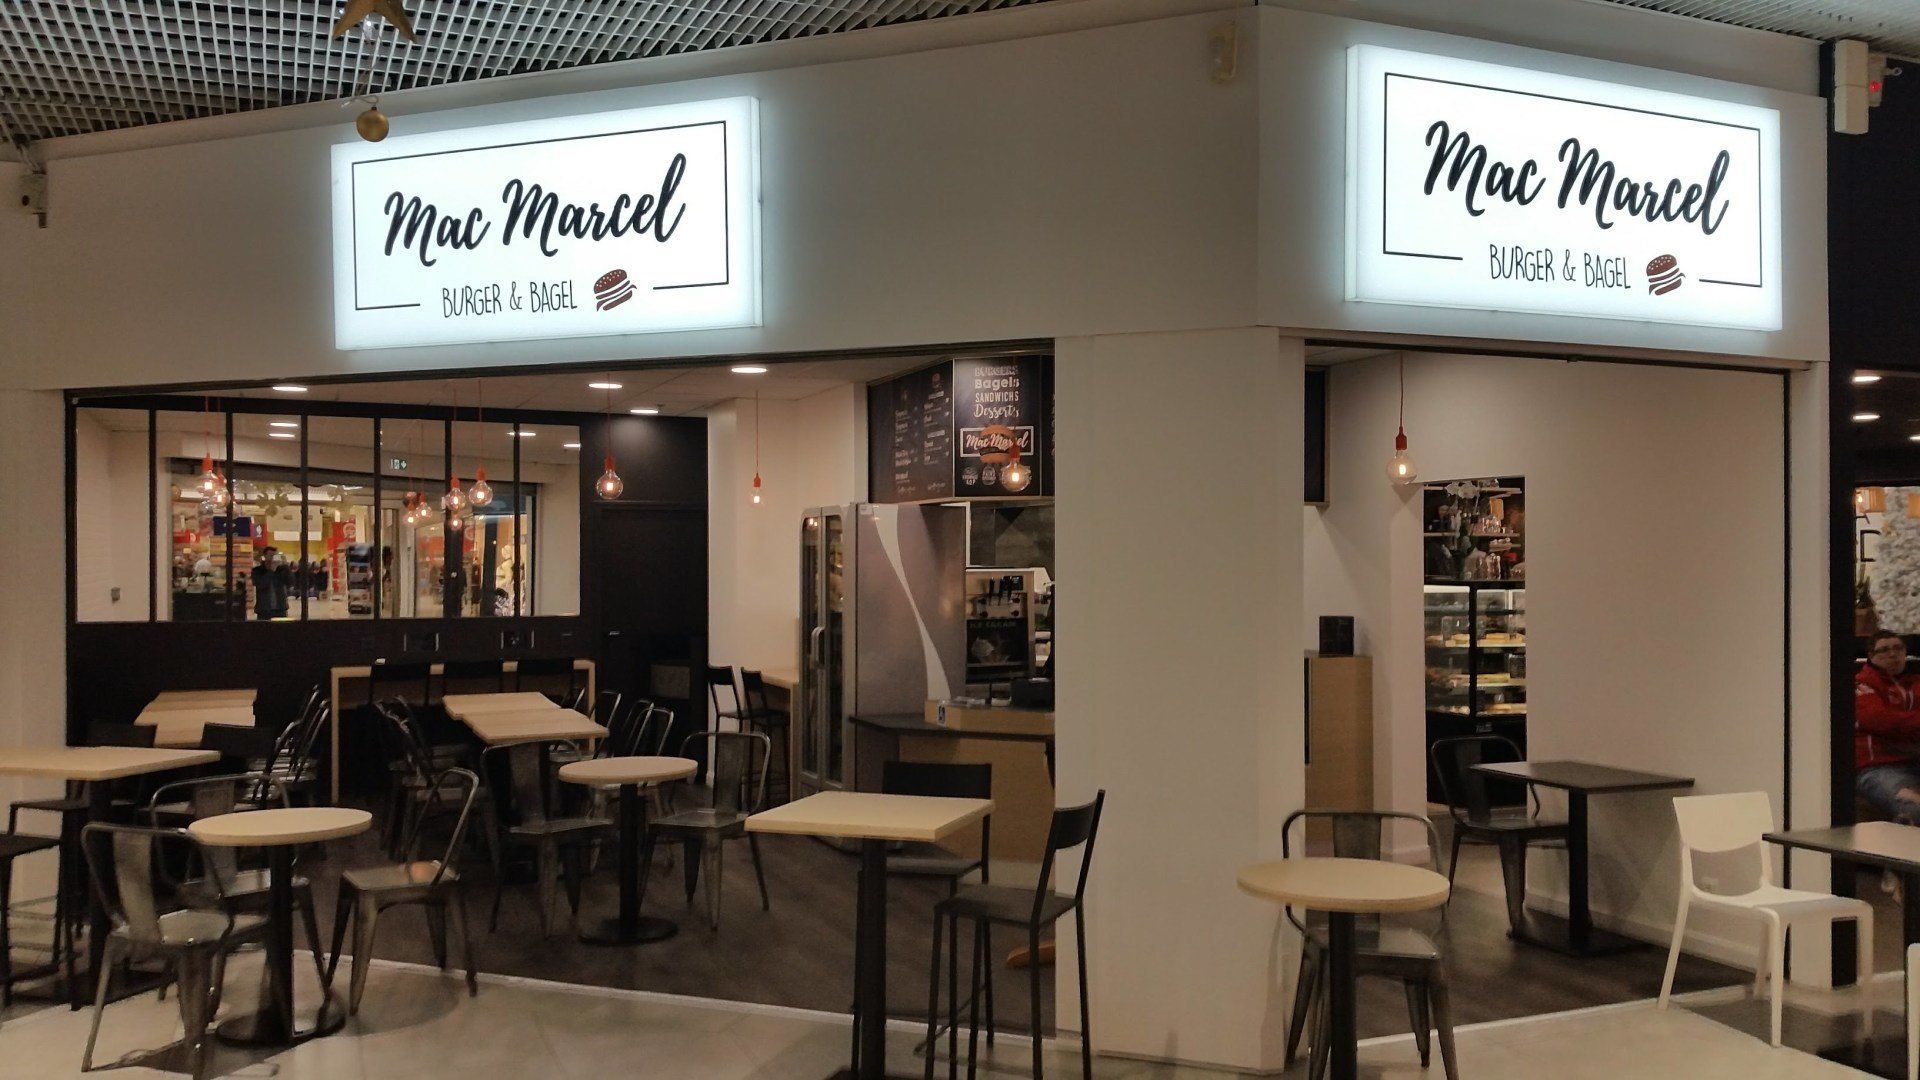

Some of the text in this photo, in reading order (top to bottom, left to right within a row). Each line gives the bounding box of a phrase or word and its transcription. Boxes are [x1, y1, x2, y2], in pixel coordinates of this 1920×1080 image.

[1424, 121, 1729, 235] Mac Marcel
[384, 153, 686, 267] Mac Marcel
[1490, 244, 1631, 289] BURGER & BAGEL
[443, 280, 578, 318] BURGER & BAGEL
[974, 377, 1019, 390] Bagels
[975, 391, 1019, 403] SANDWICHS
[966, 434, 990, 451] Mac
[989, 431, 1028, 451] Marel
